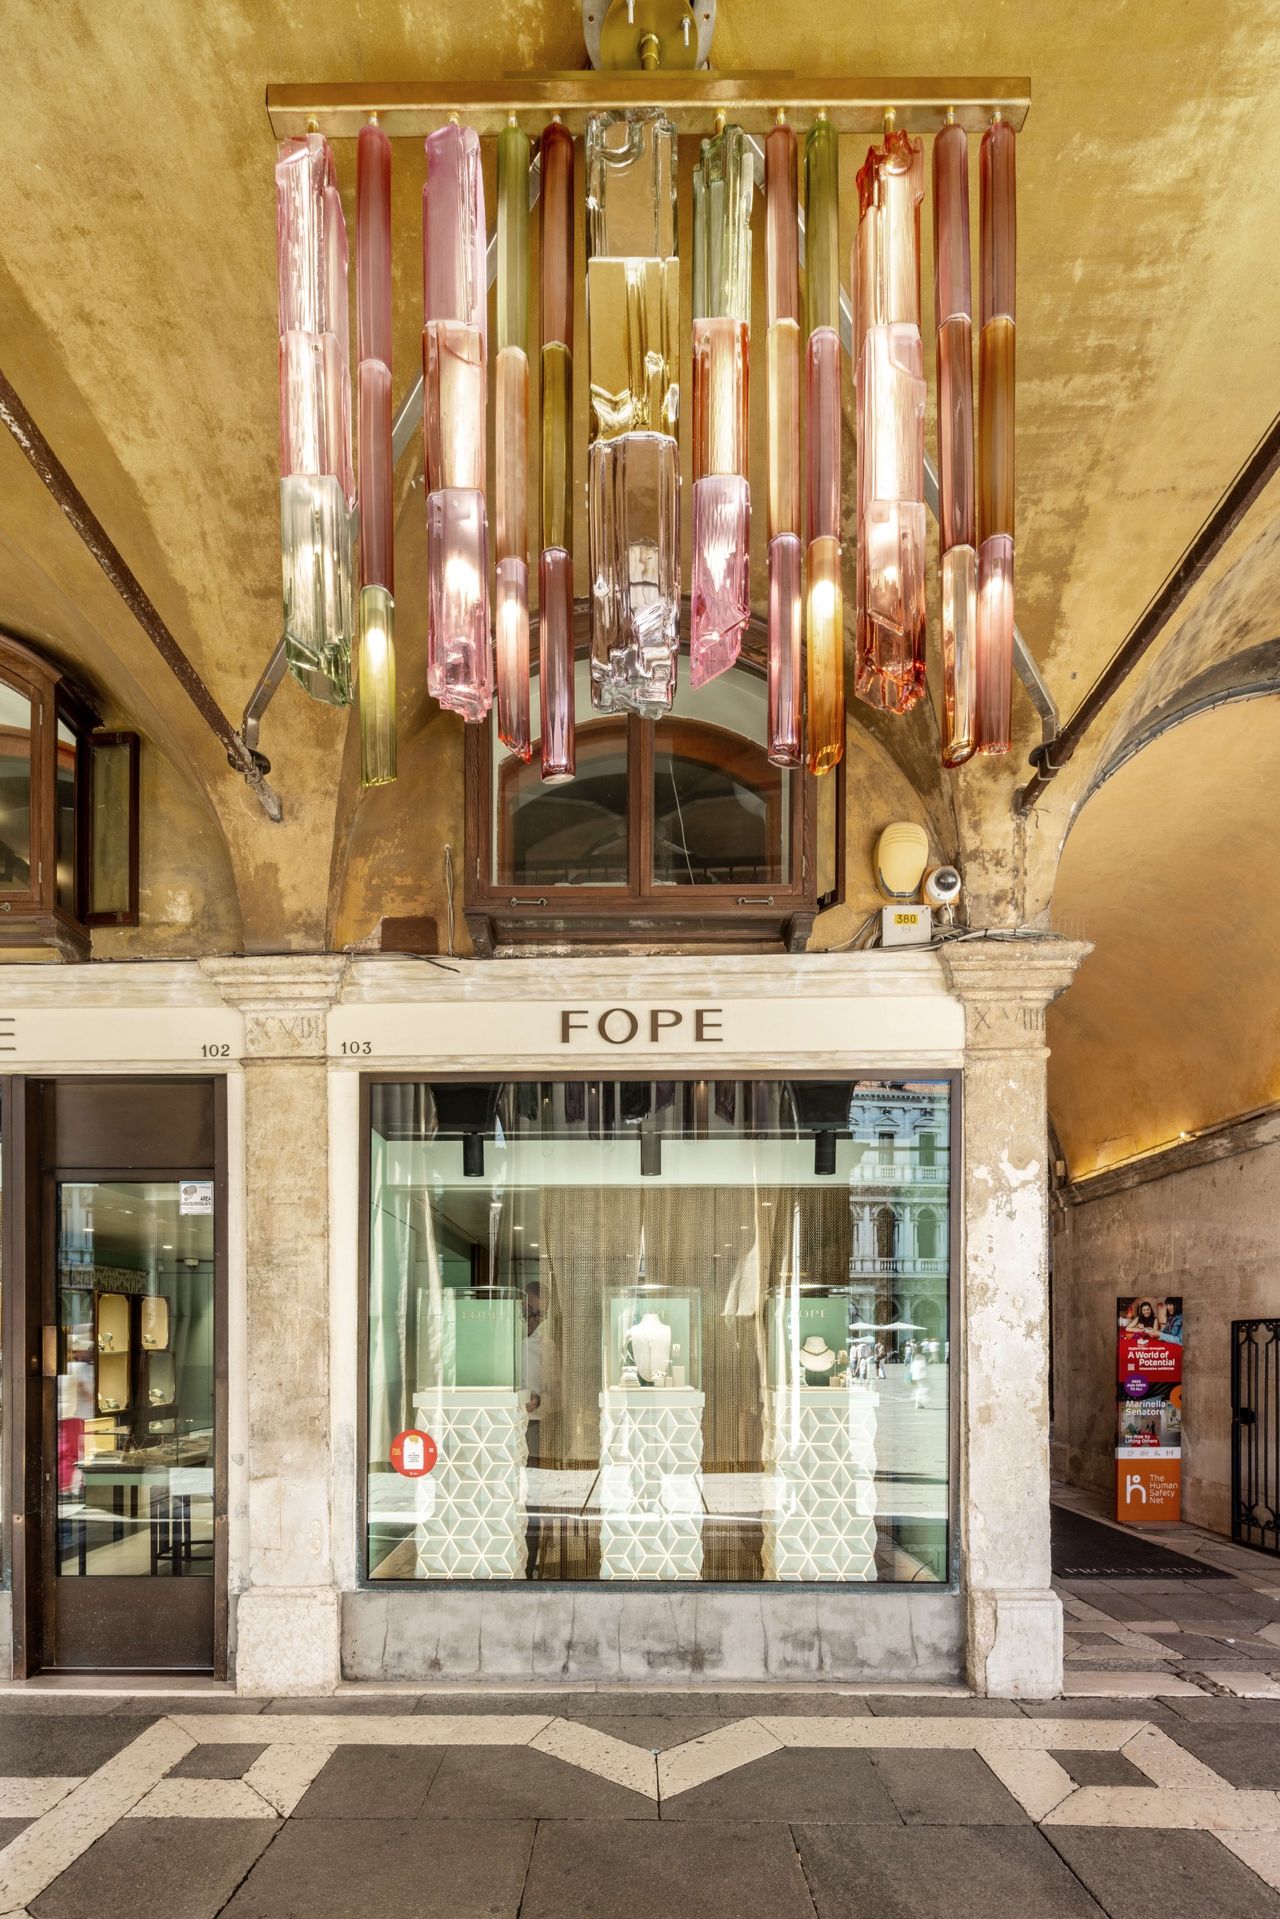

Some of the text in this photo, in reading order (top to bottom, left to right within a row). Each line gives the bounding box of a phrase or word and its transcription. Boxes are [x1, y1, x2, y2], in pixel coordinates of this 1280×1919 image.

[896, 914, 916, 924] 380
[560, 1008, 723, 1044] FOPE
[201, 1044, 230, 1057] 102
[341, 1041, 372, 1054] 103
[1128, 1351, 1169, 1359] A World of
[1125, 1400, 1166, 1408] Marinella
[1125, 1408, 1165, 1416] Senatore
[1150, 1489, 1175, 1498] Safety
